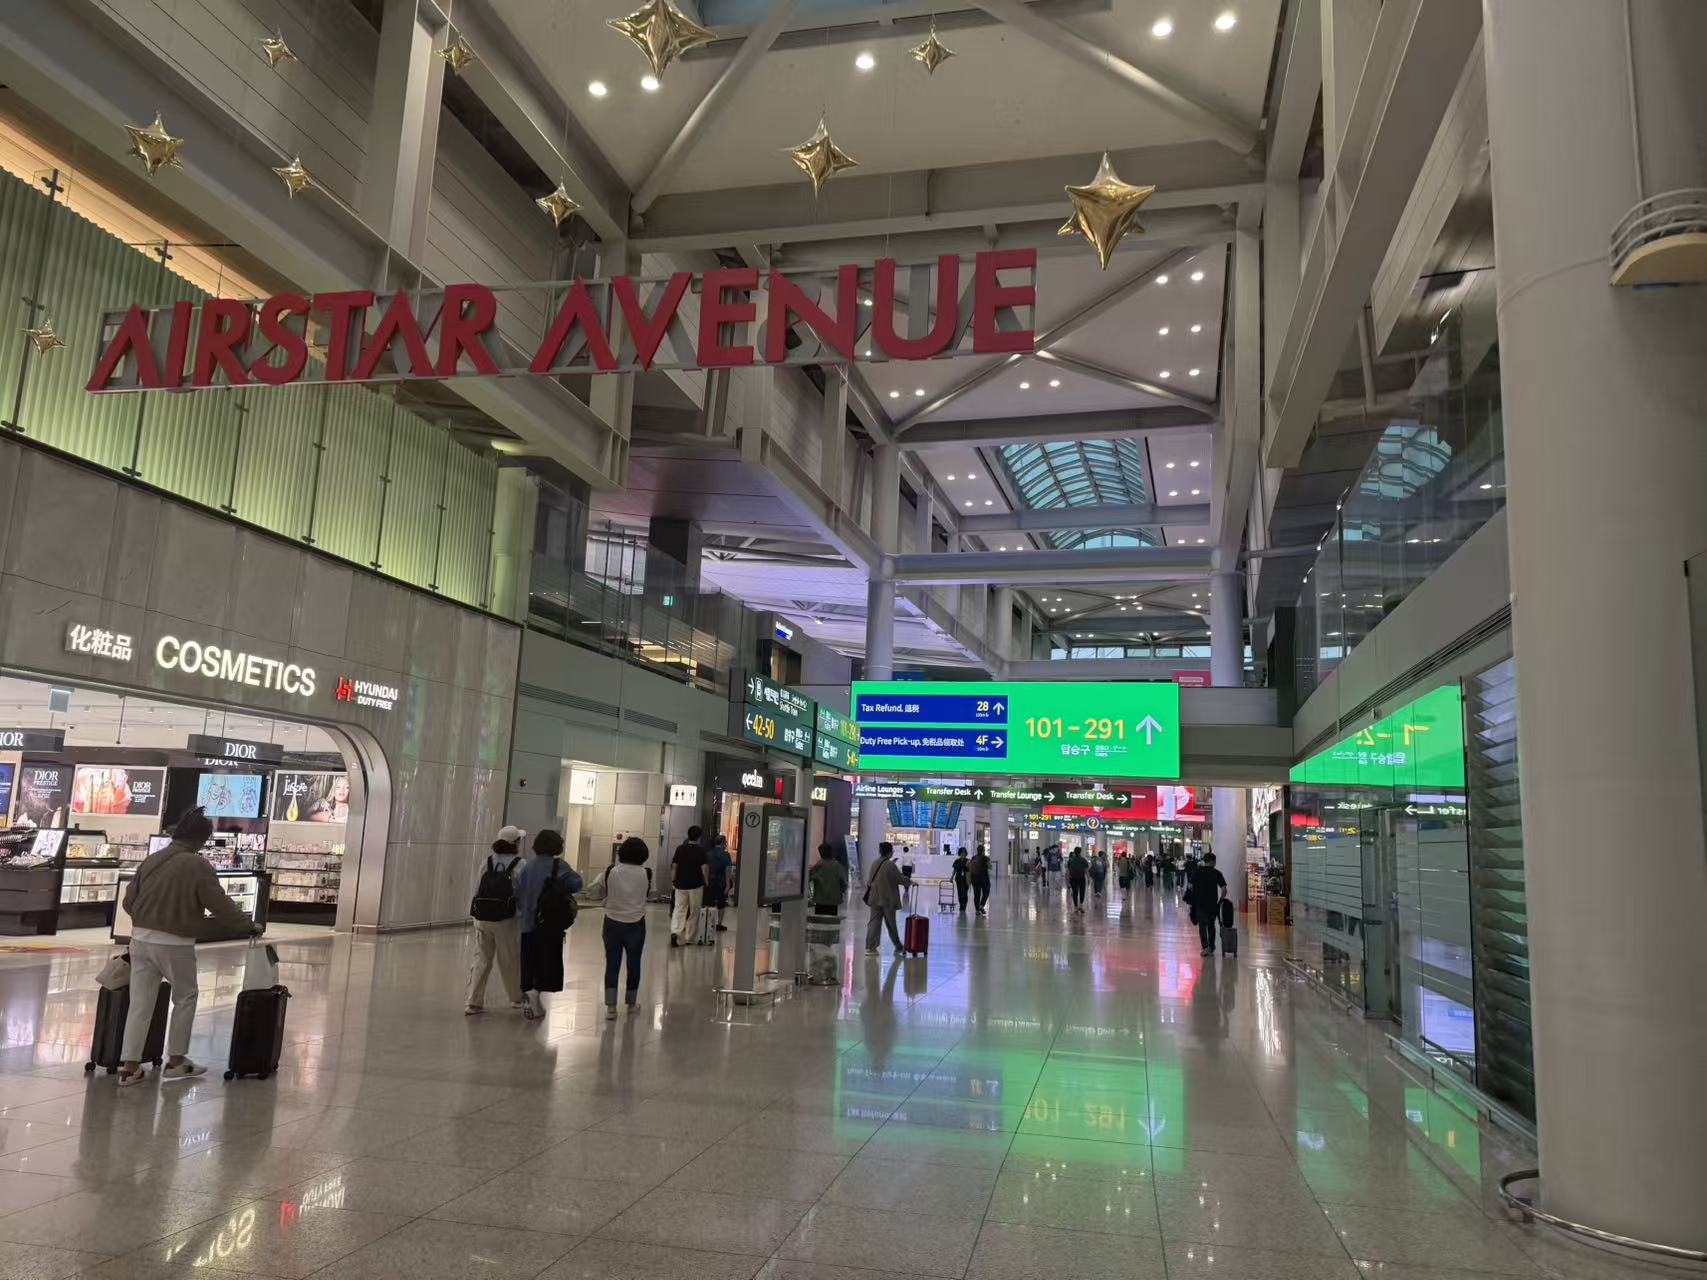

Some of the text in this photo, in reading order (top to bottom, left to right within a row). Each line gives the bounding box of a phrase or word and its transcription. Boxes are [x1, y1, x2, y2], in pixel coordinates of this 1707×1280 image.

[86, 248, 1037, 393] AIRSTAR AVENUE
[70, 624, 132, 661] 化粧品
[155, 636, 316, 696] COSMETICS
[355, 680, 398, 700] HYUNDAI
[358, 695, 393, 710] DUTY FREE
[861, 703, 874, 712] Tax
[976, 701, 989, 712] 28
[753, 714, 775, 740] 42-50
[860, 737, 876, 746] Duty
[877, 737, 892, 745] Free
[976, 735, 989, 746] 4F
[224, 742, 257, 760] DIOR
[1061, 744, 1091, 757] 탑승구
[34, 770, 59, 781] DIOR
[856, 785, 876, 793] Airline
[877, 785, 904, 795] Lounges
[926, 787, 971, 796] Transfer Desk
[1065, 791, 1114, 800] Transfer Desk
[990, 791, 1042, 802] Transfer Lounge
